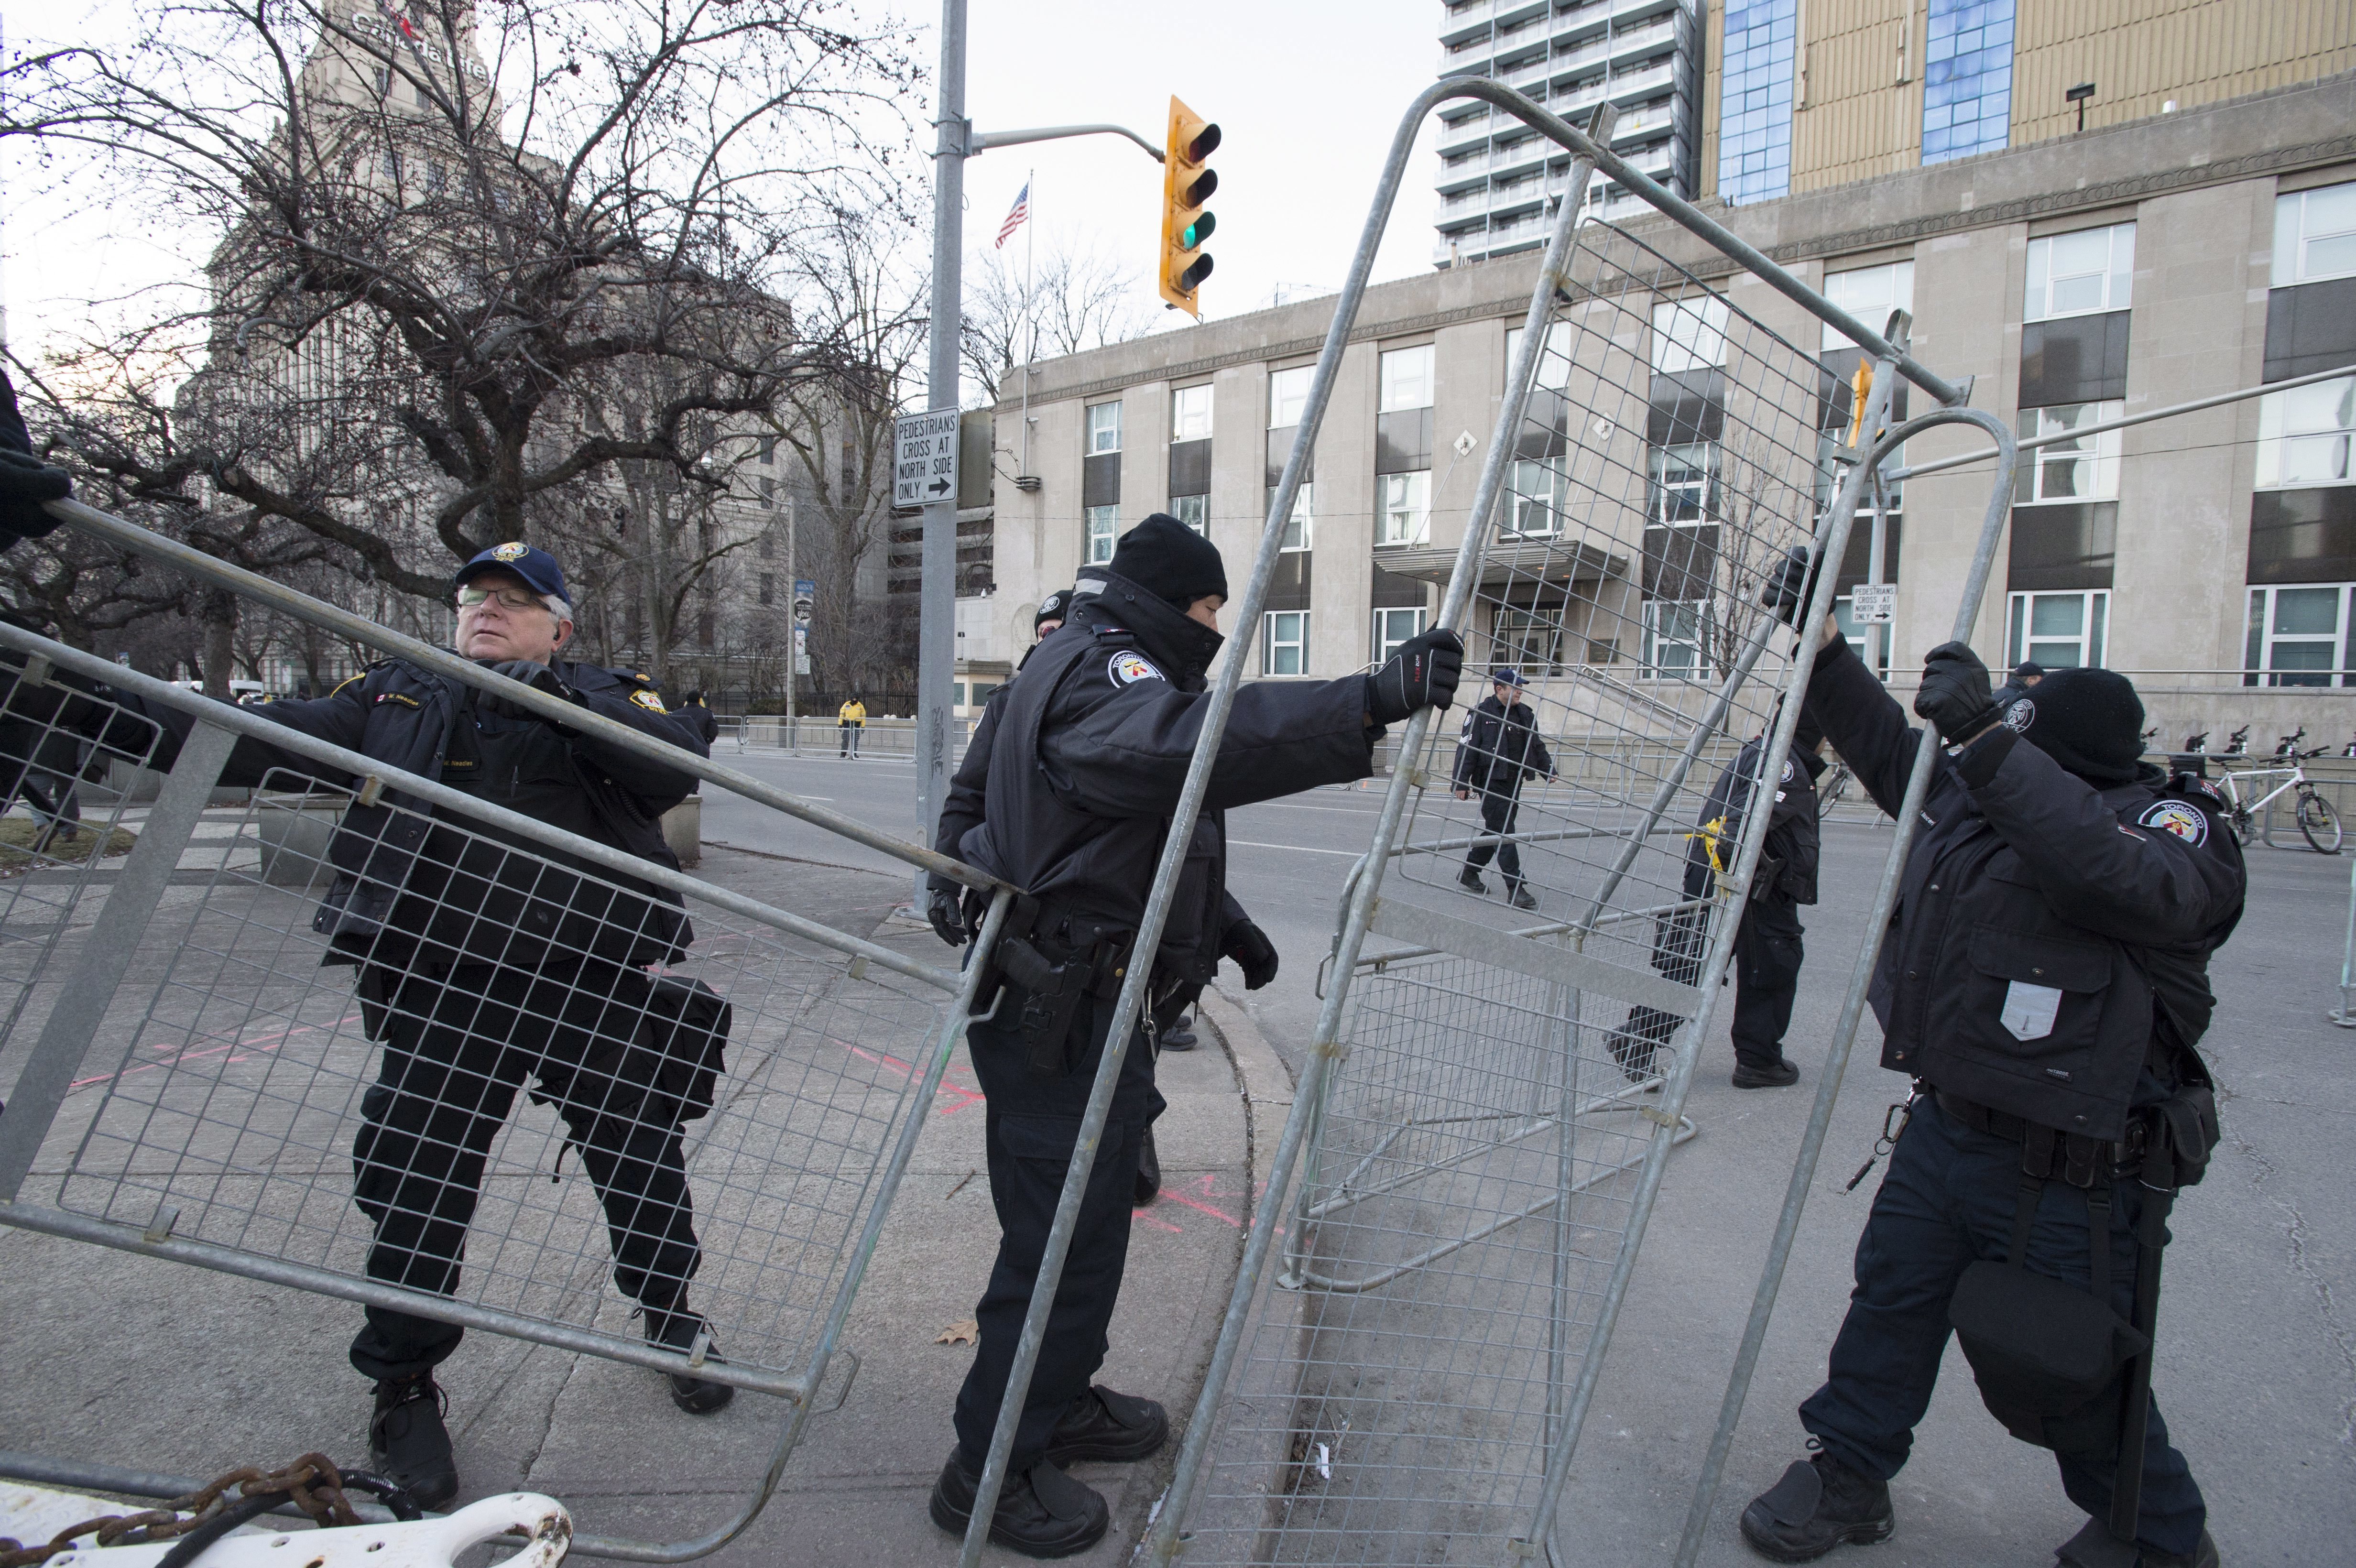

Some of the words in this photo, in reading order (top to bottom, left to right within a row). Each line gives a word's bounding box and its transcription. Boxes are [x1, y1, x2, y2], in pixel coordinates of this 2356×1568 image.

[447, 48, 487, 79] Life
[899, 414, 955, 440] PEDESTRIANS
[903, 439, 930, 459] CROSS
[938, 436, 949, 454] AT
[899, 460, 926, 480] NORTH
[933, 457, 952, 475] SIDE
[899, 481, 920, 500] ONLY
[1854, 587, 1894, 596] PEDESTRIANS
[1113, 653, 1143, 669] TORONTO
[2161, 804, 2204, 829] TORONTO
